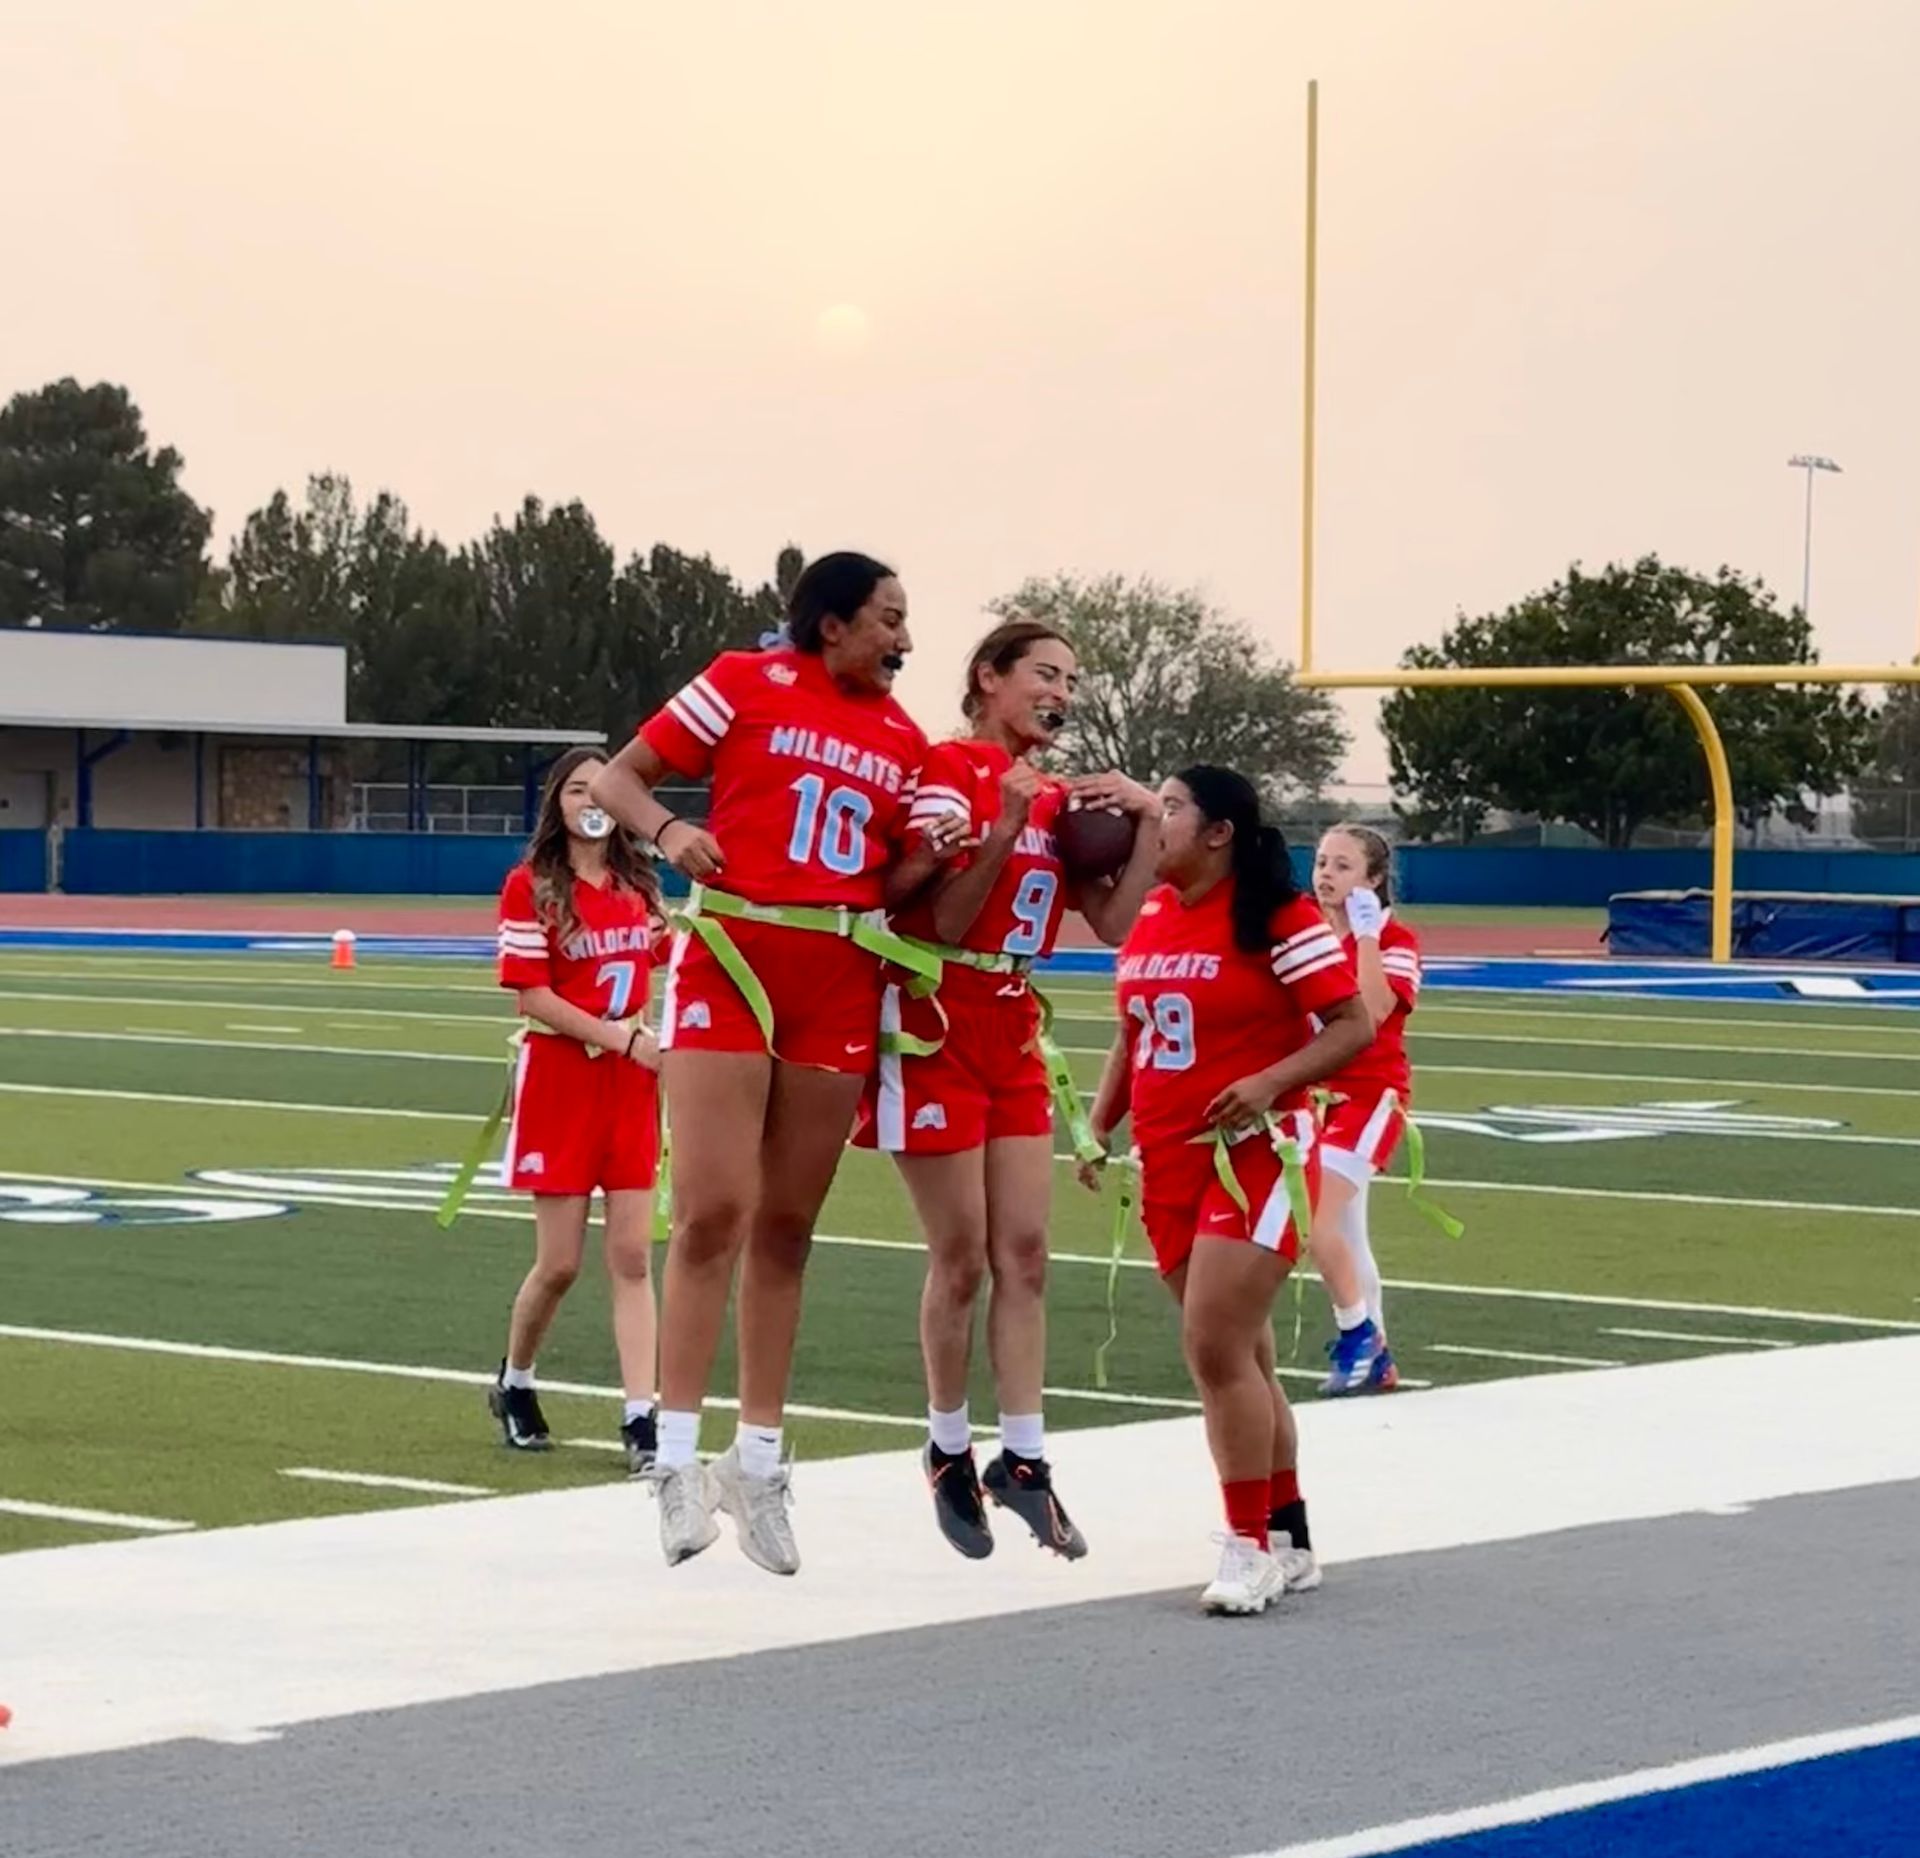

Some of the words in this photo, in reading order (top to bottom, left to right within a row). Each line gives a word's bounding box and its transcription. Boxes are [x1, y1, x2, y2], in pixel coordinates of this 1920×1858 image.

[769, 725, 903, 794] WILDCATS
[788, 772, 874, 876] 10
[562, 926, 650, 961] WILDCAT
[1002, 868, 1058, 955] 9
[595, 960, 636, 1017] 7
[1128, 992, 1197, 1070] 19
